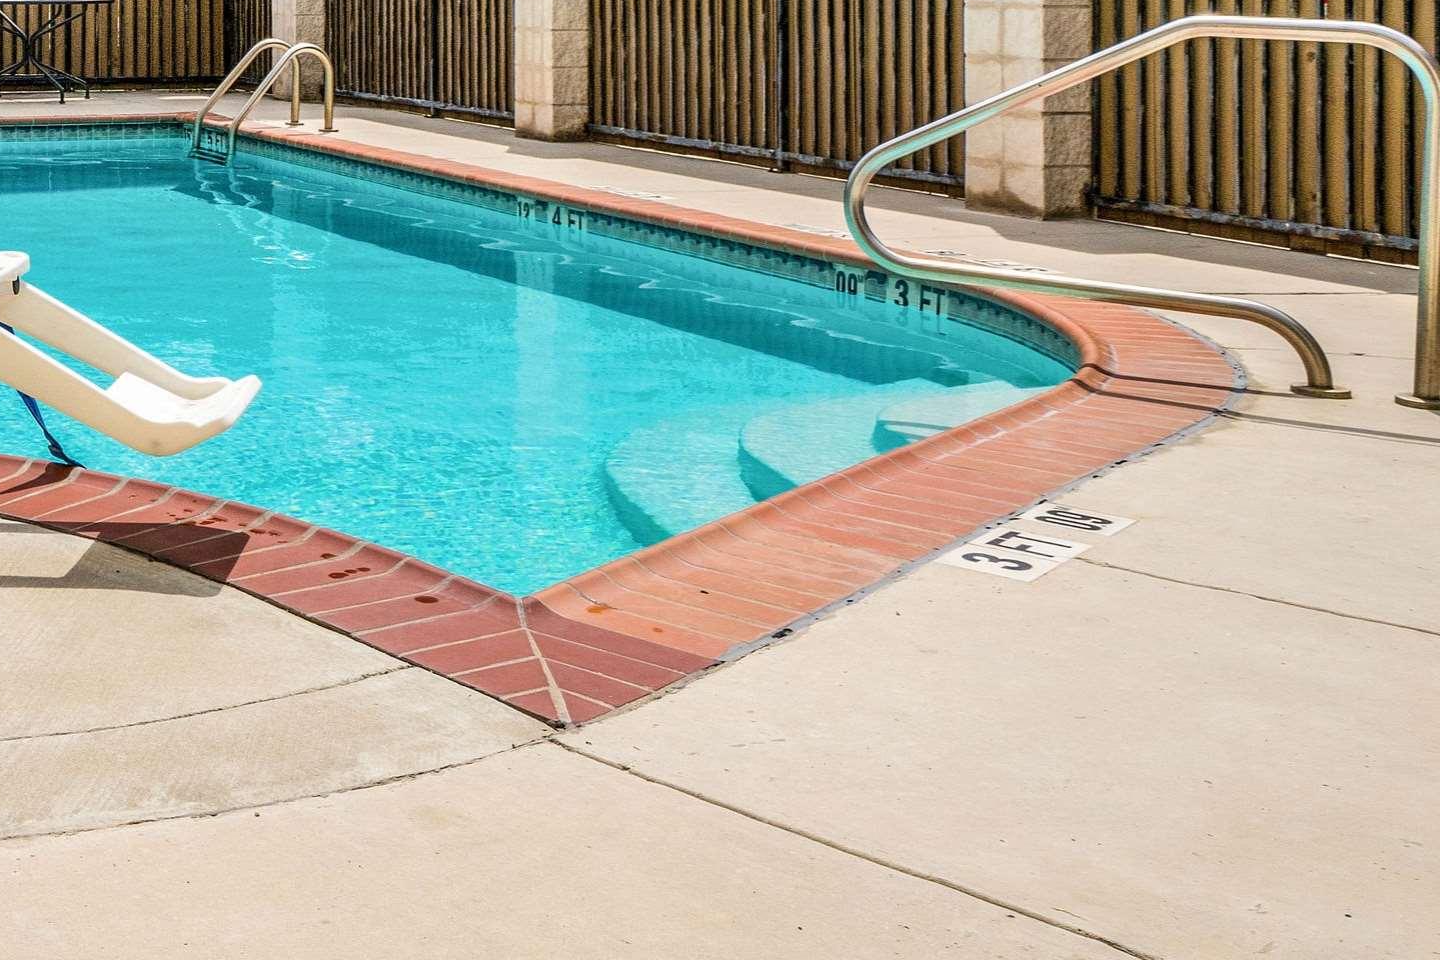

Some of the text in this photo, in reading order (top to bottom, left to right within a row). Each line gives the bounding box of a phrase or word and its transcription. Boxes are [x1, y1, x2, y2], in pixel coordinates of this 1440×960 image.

[552, 206, 562, 225] 4
[568, 209, 585, 230] FT
[894, 279, 909, 307] 3
[919, 284, 946, 315] FT
[986, 531, 1073, 558] FT
[961, 552, 1034, 572] 3
